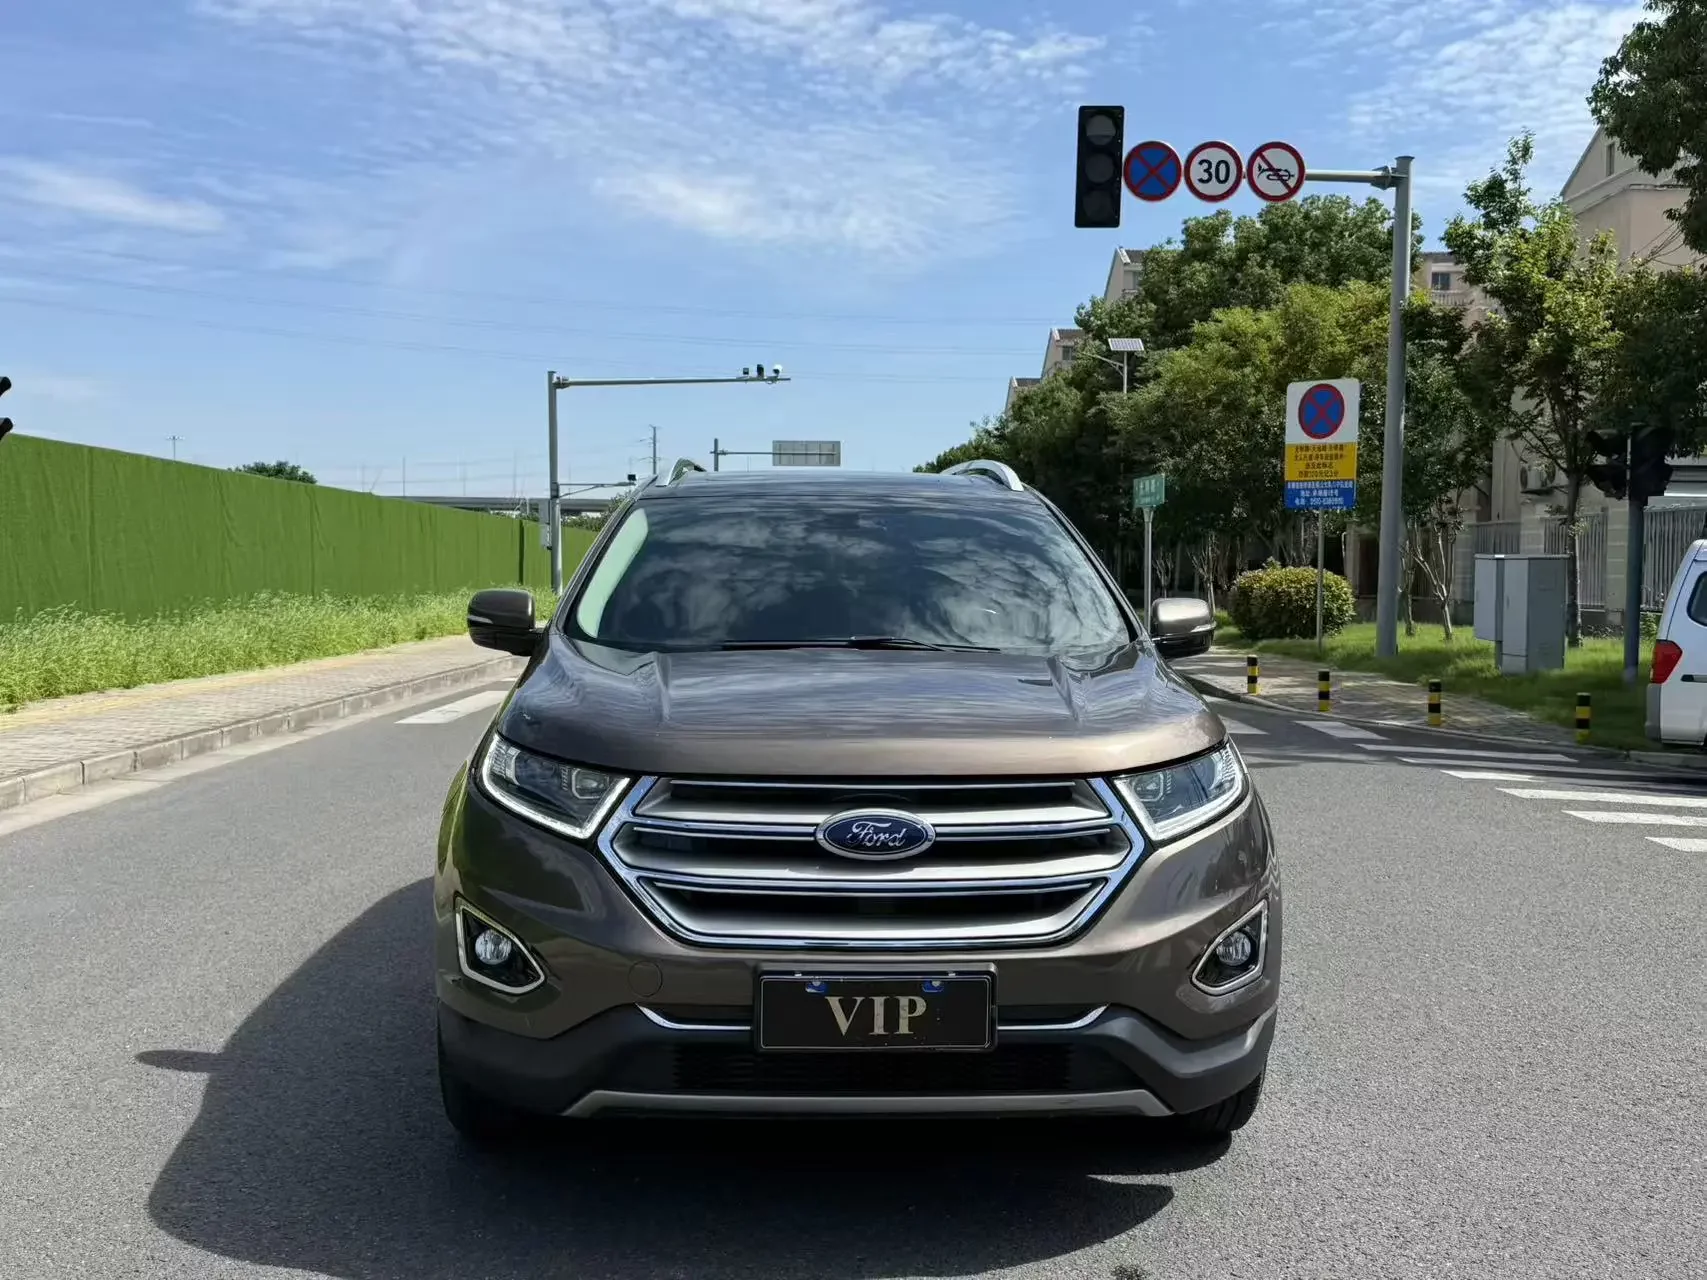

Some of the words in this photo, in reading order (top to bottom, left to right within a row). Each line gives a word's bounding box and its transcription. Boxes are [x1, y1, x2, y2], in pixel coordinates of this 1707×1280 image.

[1197, 158, 1230, 185] 30
[845, 820, 908, 848] Ford
[824, 995, 928, 1037] VIP
